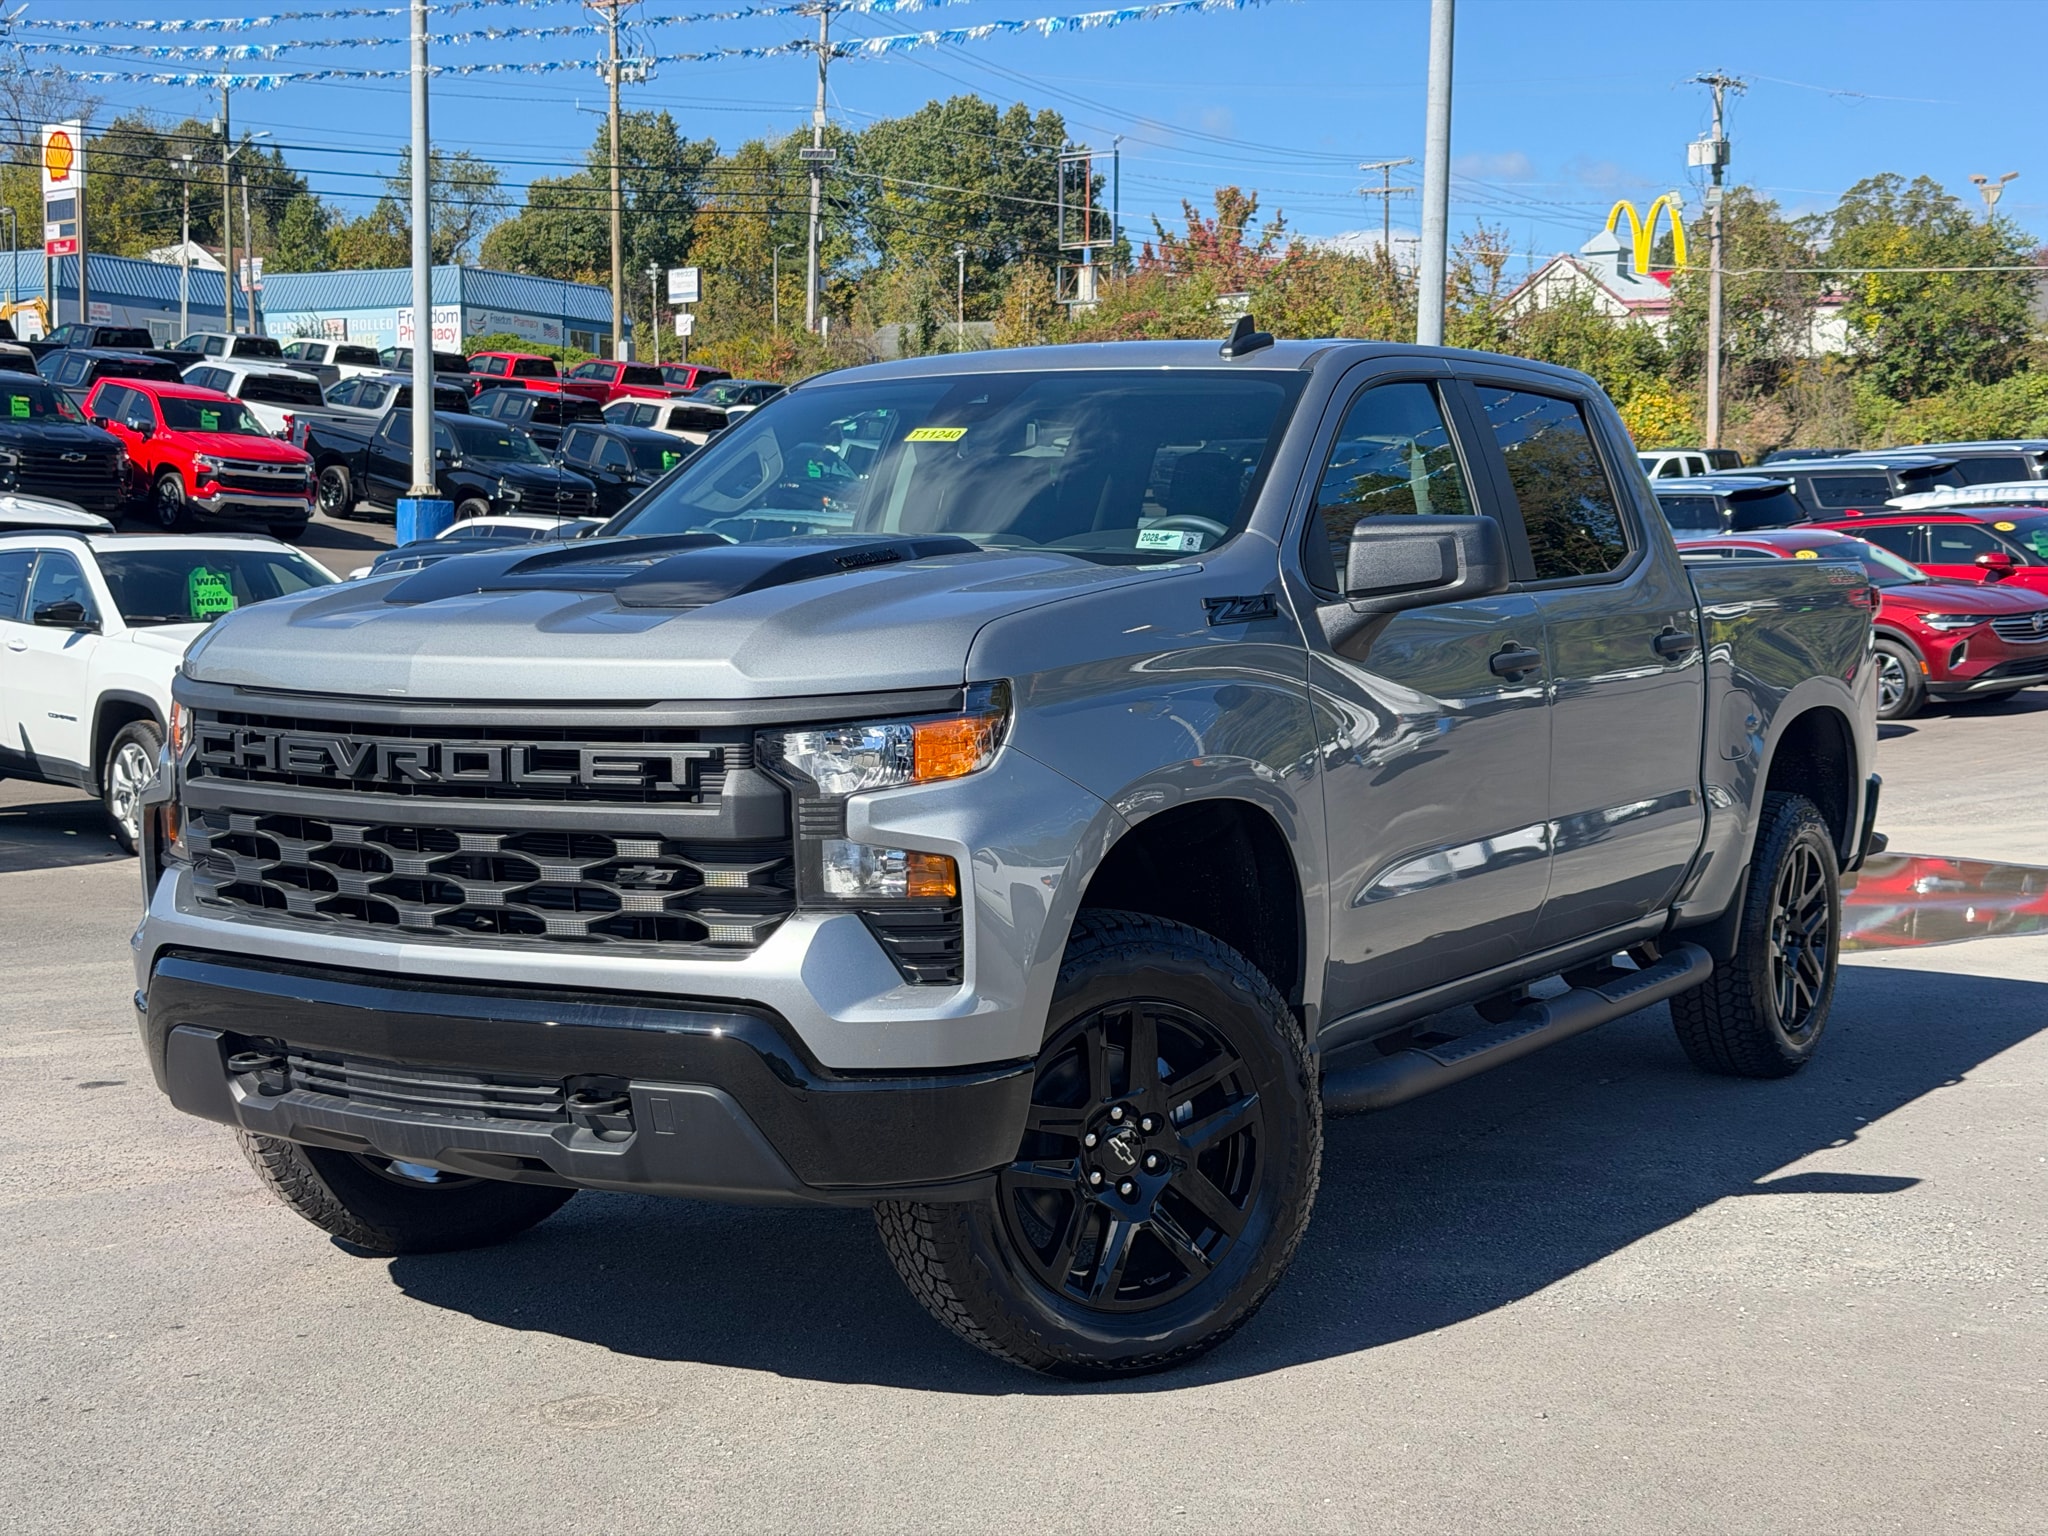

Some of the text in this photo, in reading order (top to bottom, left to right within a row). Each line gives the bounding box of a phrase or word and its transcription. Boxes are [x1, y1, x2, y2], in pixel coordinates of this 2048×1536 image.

[398, 309, 458, 325] Frdom
[399, 325, 457, 344] Phacy
[911, 430, 962, 439] T11240
[1186, 537, 1195, 546] 9
[196, 577, 227, 586] WAS
[196, 597, 229, 606] NOW
[1202, 594, 1278, 627] Z71
[198, 726, 720, 788] CHEVROLET
